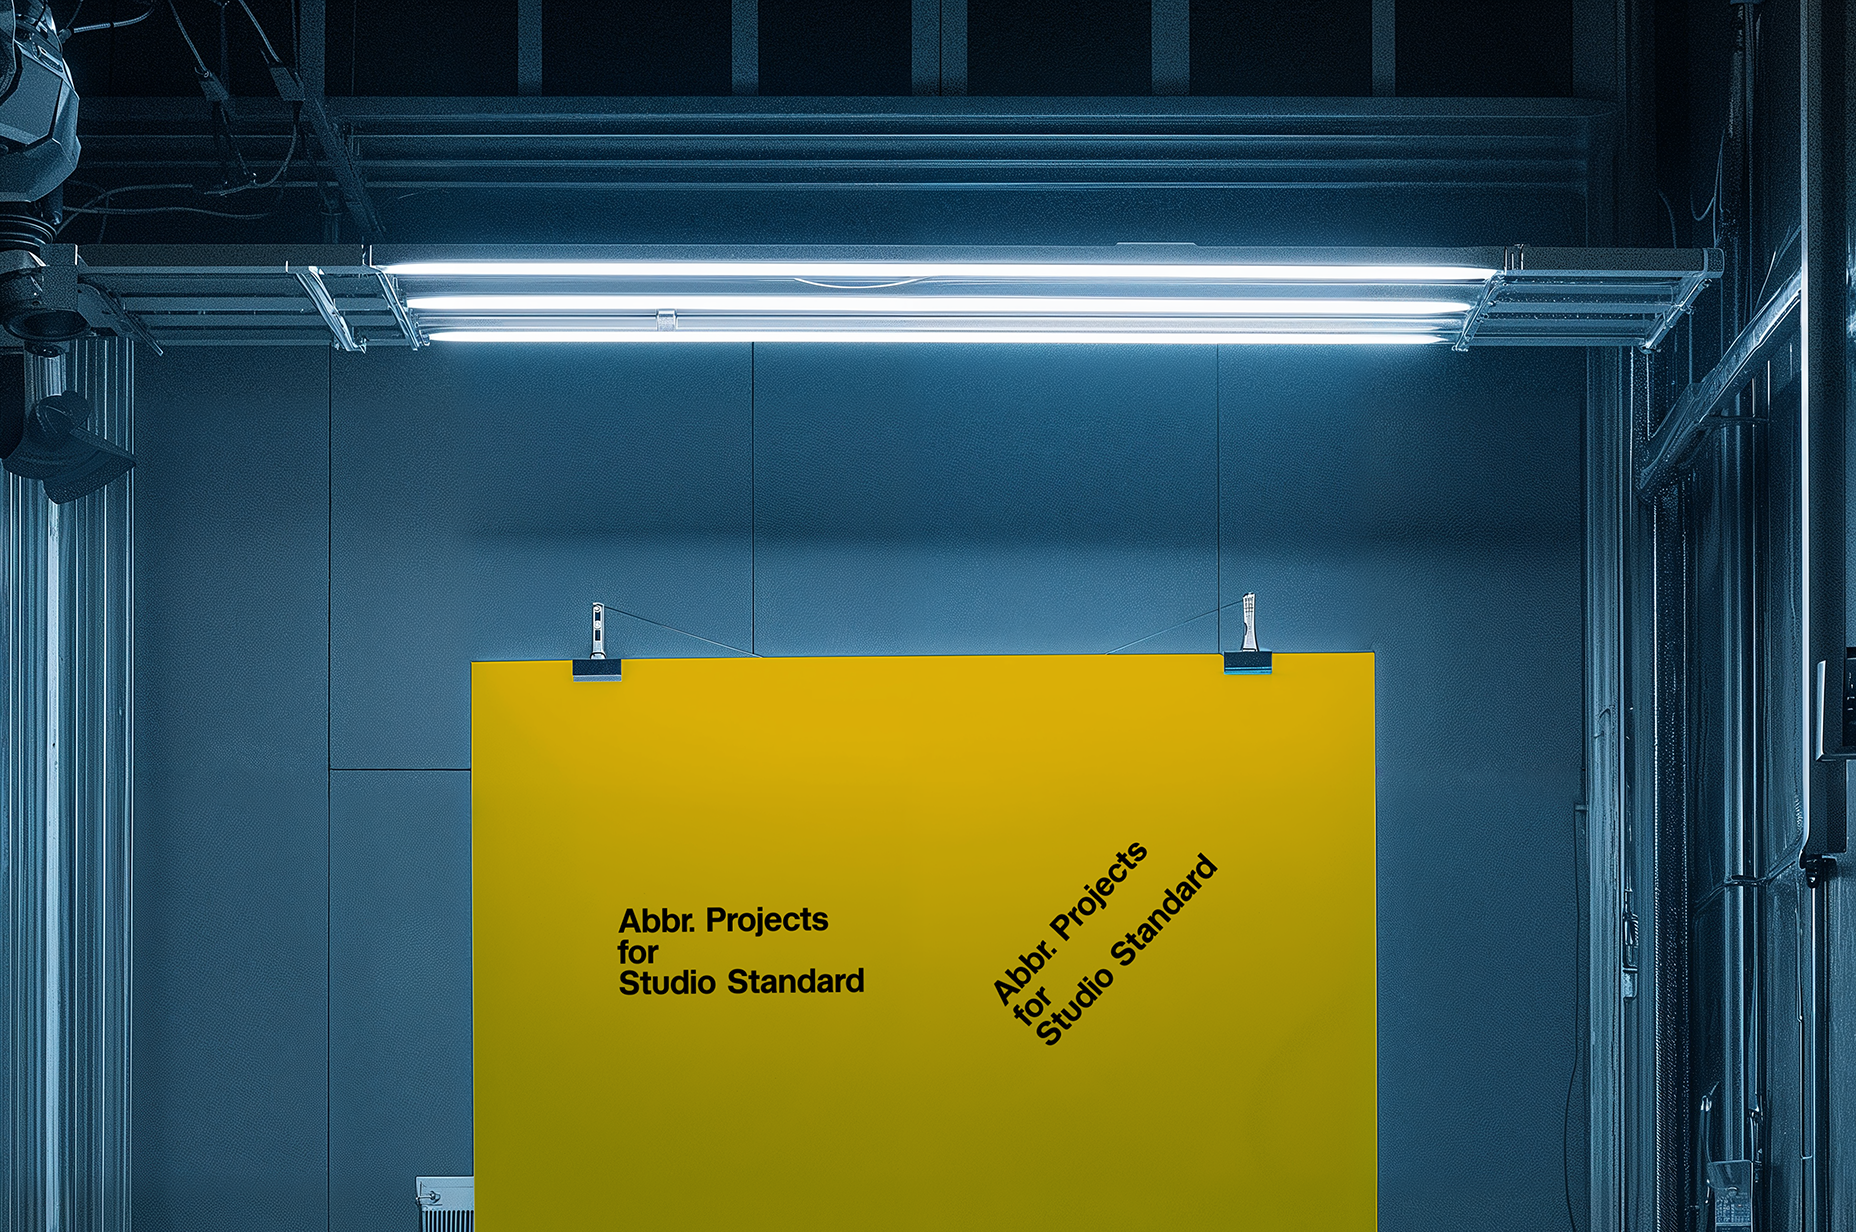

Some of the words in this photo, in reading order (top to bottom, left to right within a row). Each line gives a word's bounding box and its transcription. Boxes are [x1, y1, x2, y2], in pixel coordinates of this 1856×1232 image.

[618, 907, 695, 934] Abbr.
[706, 906, 829, 937] Projects
[993, 913, 1070, 1007] Abbr.
[1049, 842, 1148, 942] Projects
[617, 939, 659, 965] for
[1036, 968, 1114, 1046] Studio
[1110, 852, 1218, 967] Standard
[619, 969, 716, 996] Studio
[727, 967, 865, 994] Standard
[1012, 986, 1052, 1027] for
